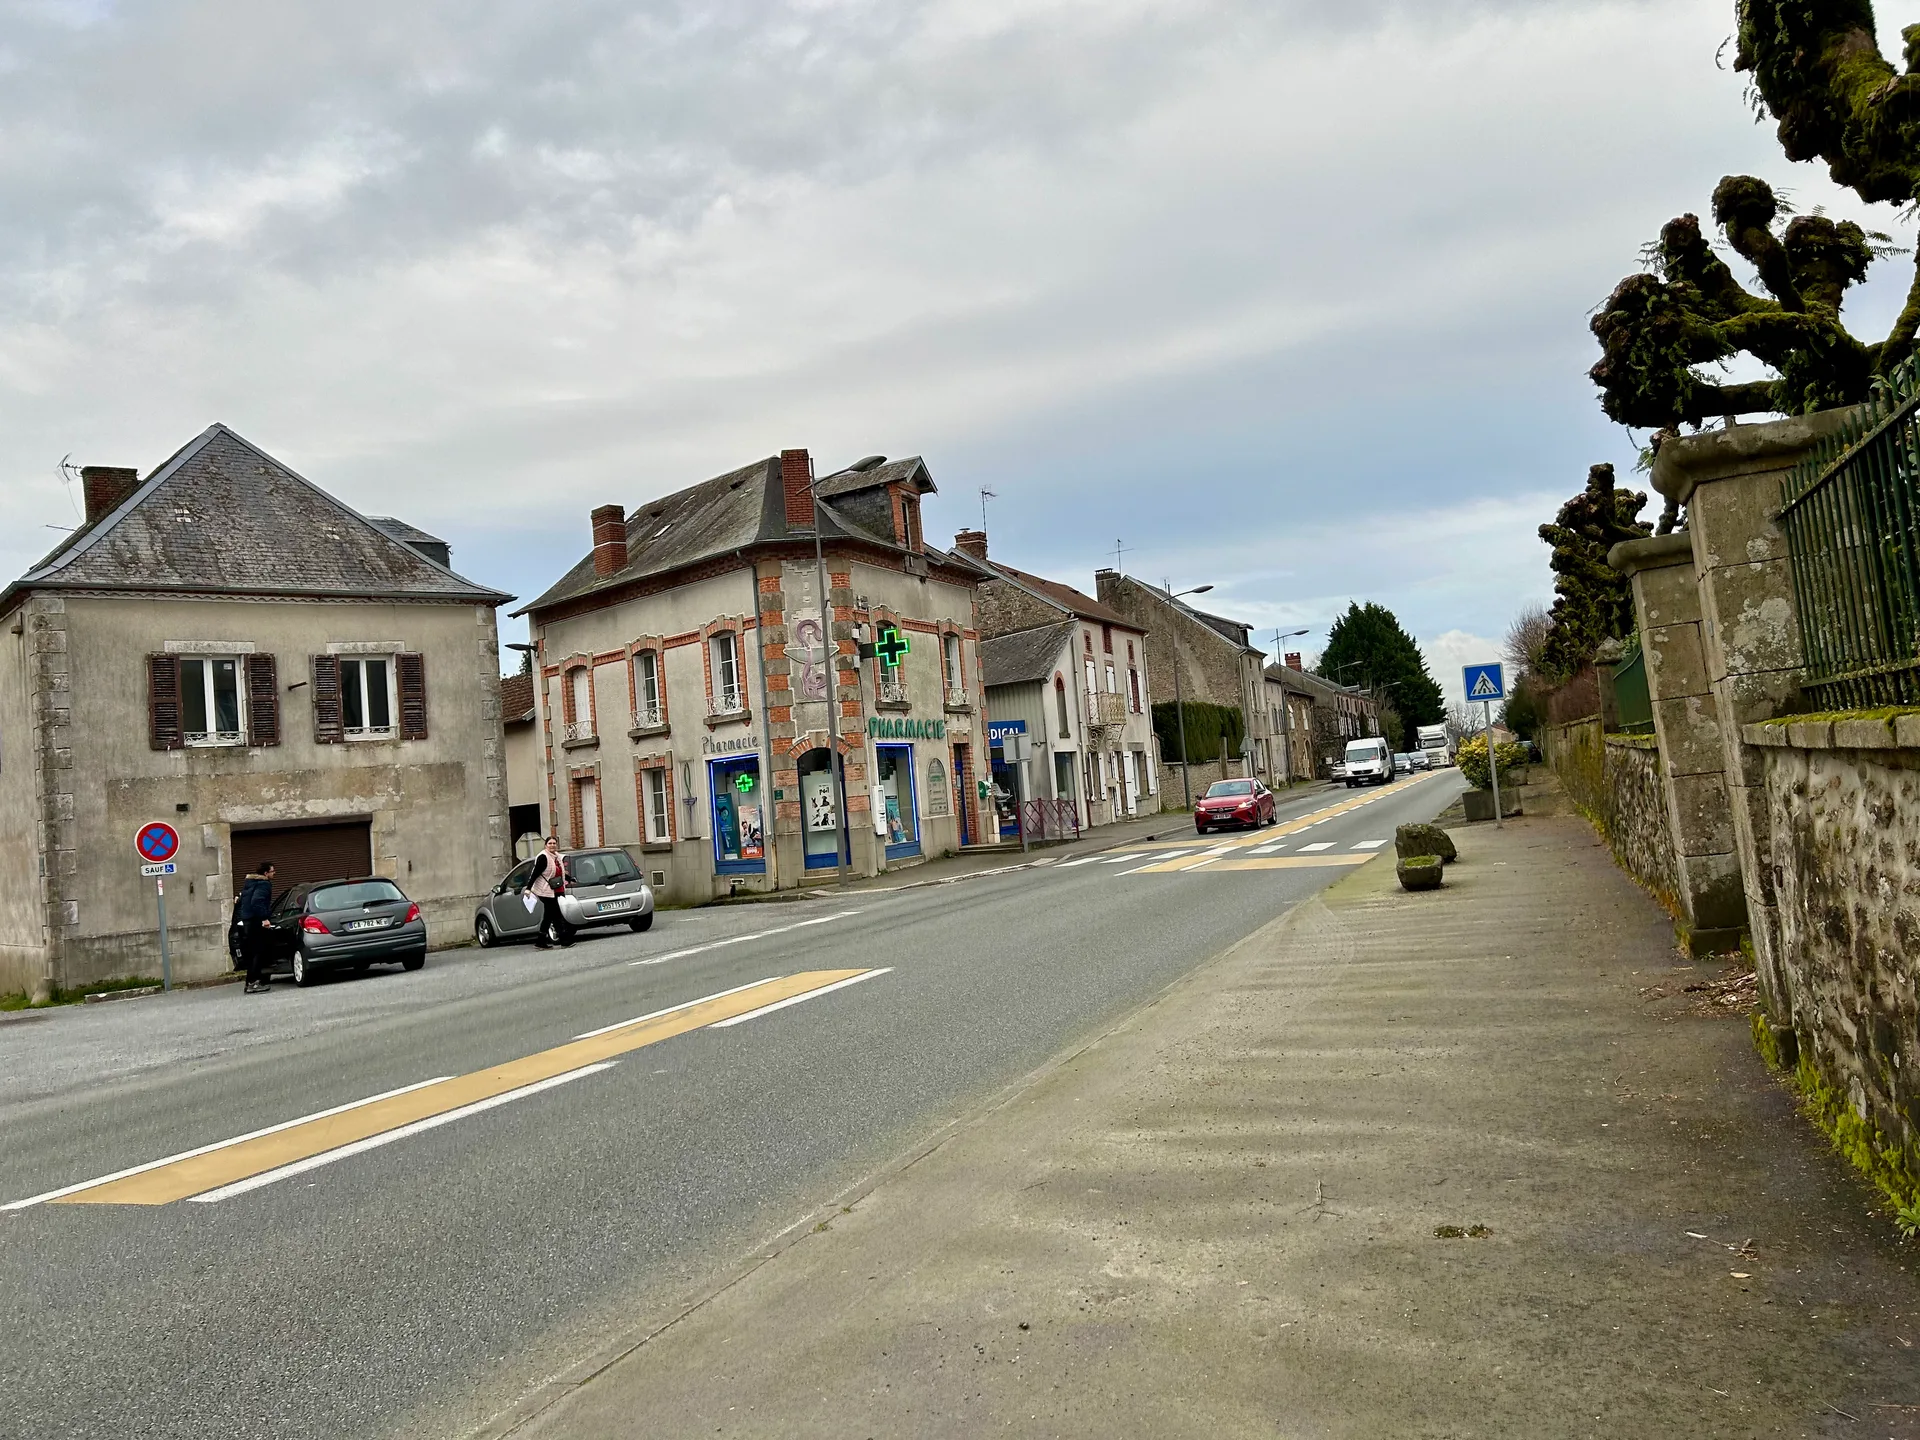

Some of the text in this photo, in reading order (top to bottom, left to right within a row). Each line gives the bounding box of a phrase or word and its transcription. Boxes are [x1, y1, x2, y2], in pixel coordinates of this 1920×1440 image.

[869, 717, 945, 739] PHARMACIE
[701, 732, 758, 754] Pharmacie
[145, 866, 164, 874] SAUF
